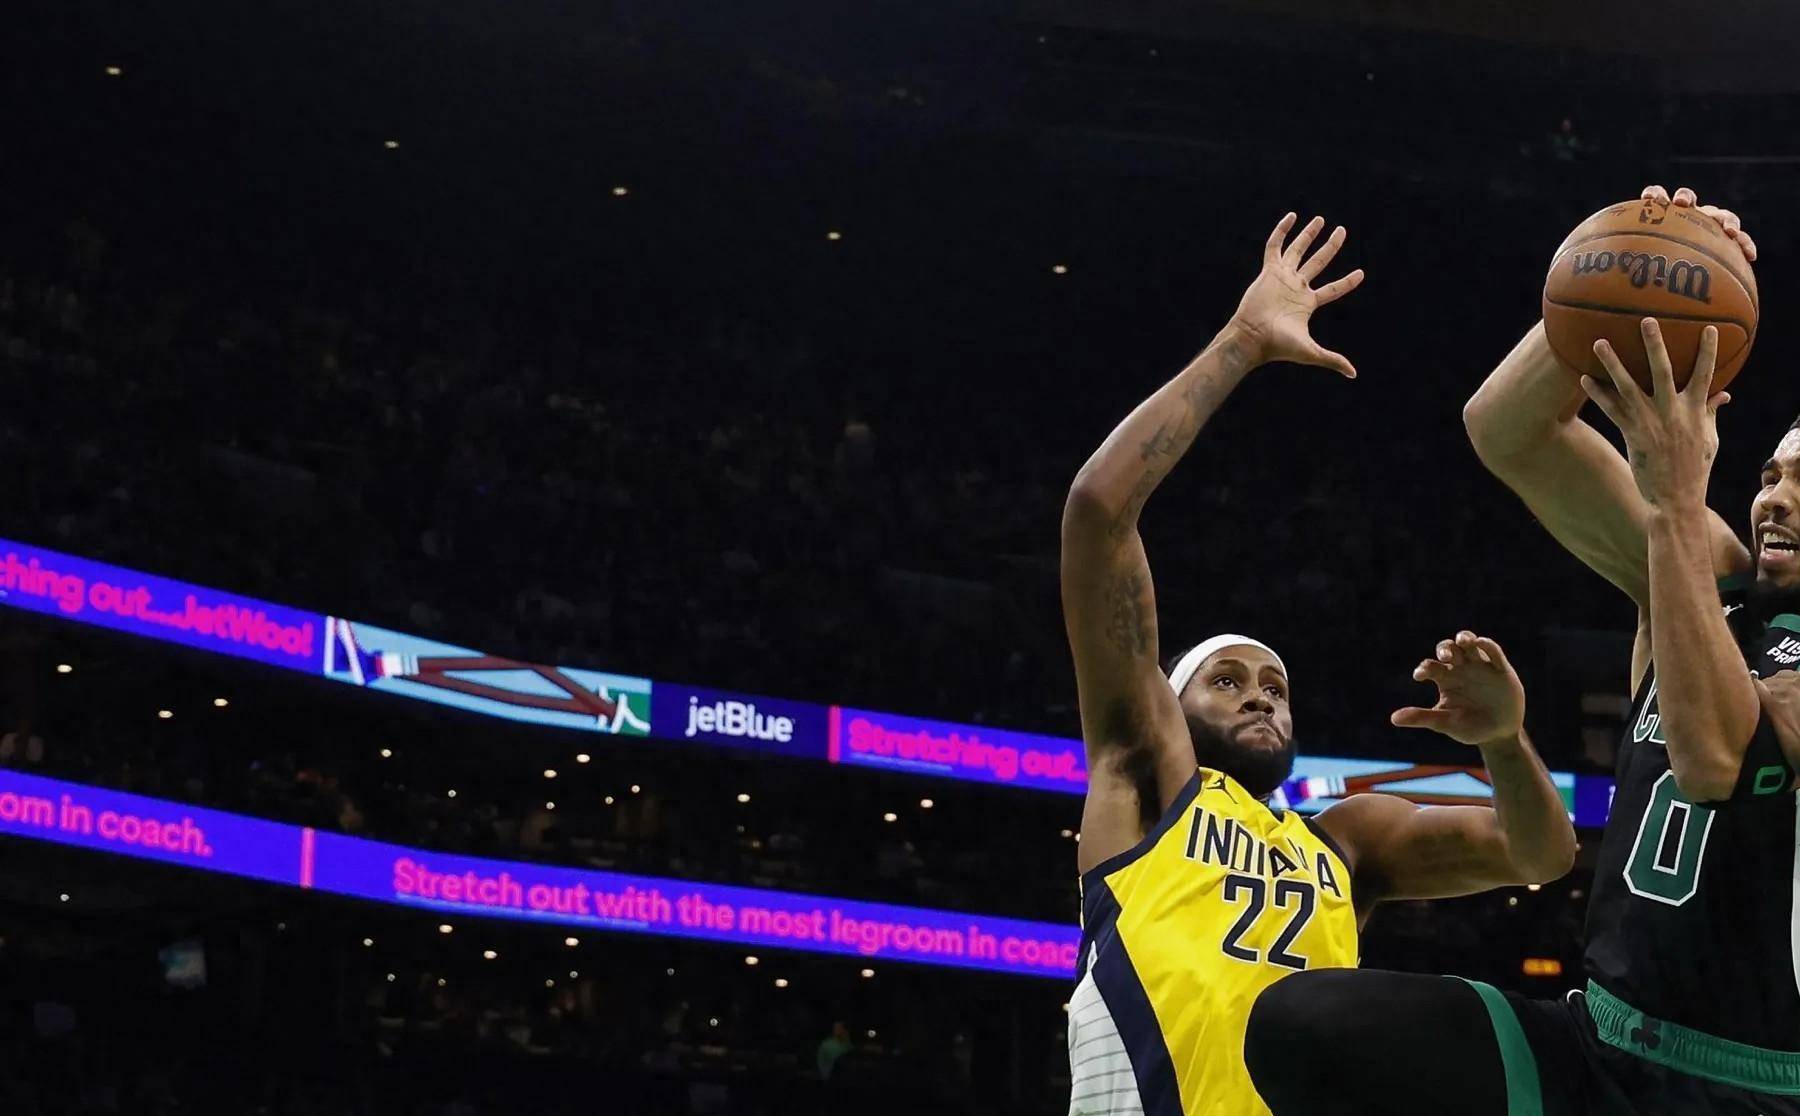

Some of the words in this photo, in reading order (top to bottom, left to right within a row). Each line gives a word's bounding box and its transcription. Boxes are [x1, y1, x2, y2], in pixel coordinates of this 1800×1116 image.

[1573, 251, 1712, 304] Wilson
[686, 696, 795, 743] jetBlue
[849, 718, 1018, 780] Stretching
[60, 794, 93, 834] in
[393, 857, 522, 908] Stretch
[527, 882, 591, 915] out
[595, 886, 672, 923] with
[676, 893, 734, 931] the
[738, 904, 826, 939] most
[830, 908, 964, 957] legroom
[966, 924, 998, 959] in
[1000, 935, 1078, 969] coac
[1222, 874, 1316, 970] 22
